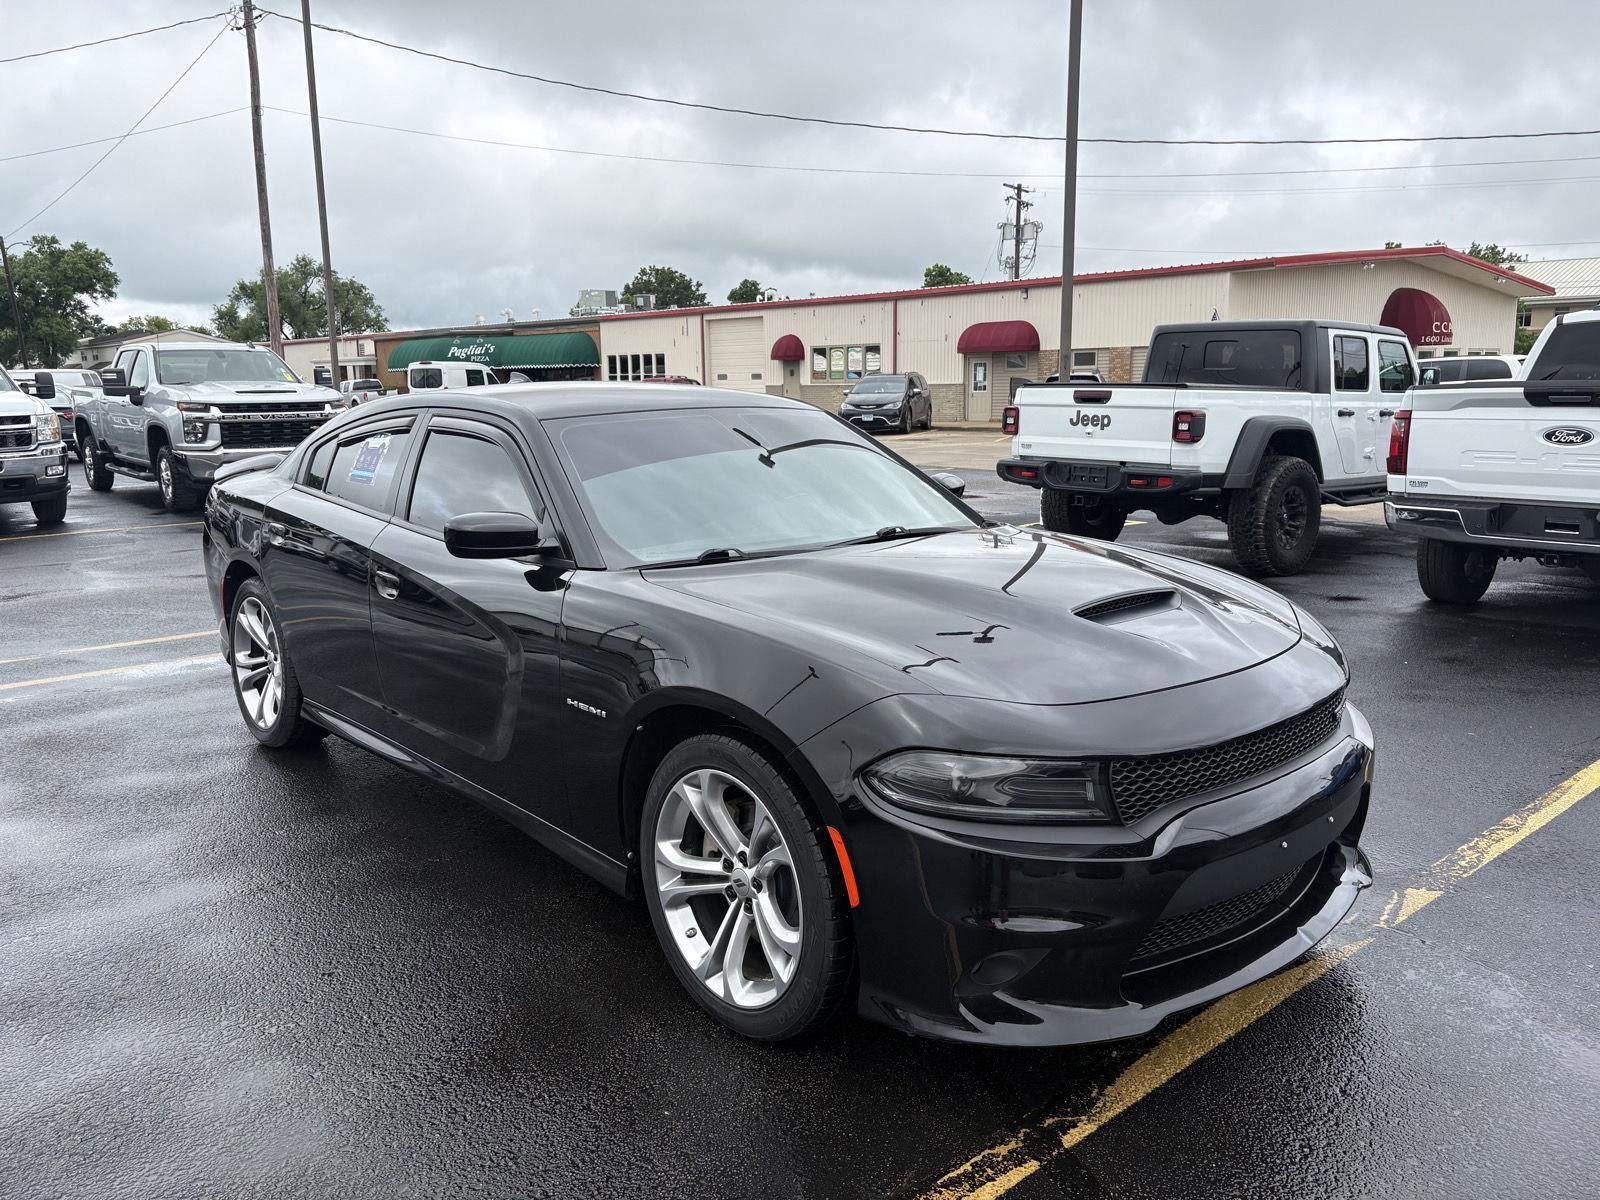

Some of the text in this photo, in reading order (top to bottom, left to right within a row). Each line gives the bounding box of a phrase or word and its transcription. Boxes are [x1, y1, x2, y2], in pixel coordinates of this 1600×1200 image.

[1420, 335, 1440, 343] 1600
[447, 343, 496, 359] Pagliai's
[1069, 410, 1112, 431] Jeep
[1551, 429, 1585, 443] Ford
[566, 697, 607, 719] HEMI
